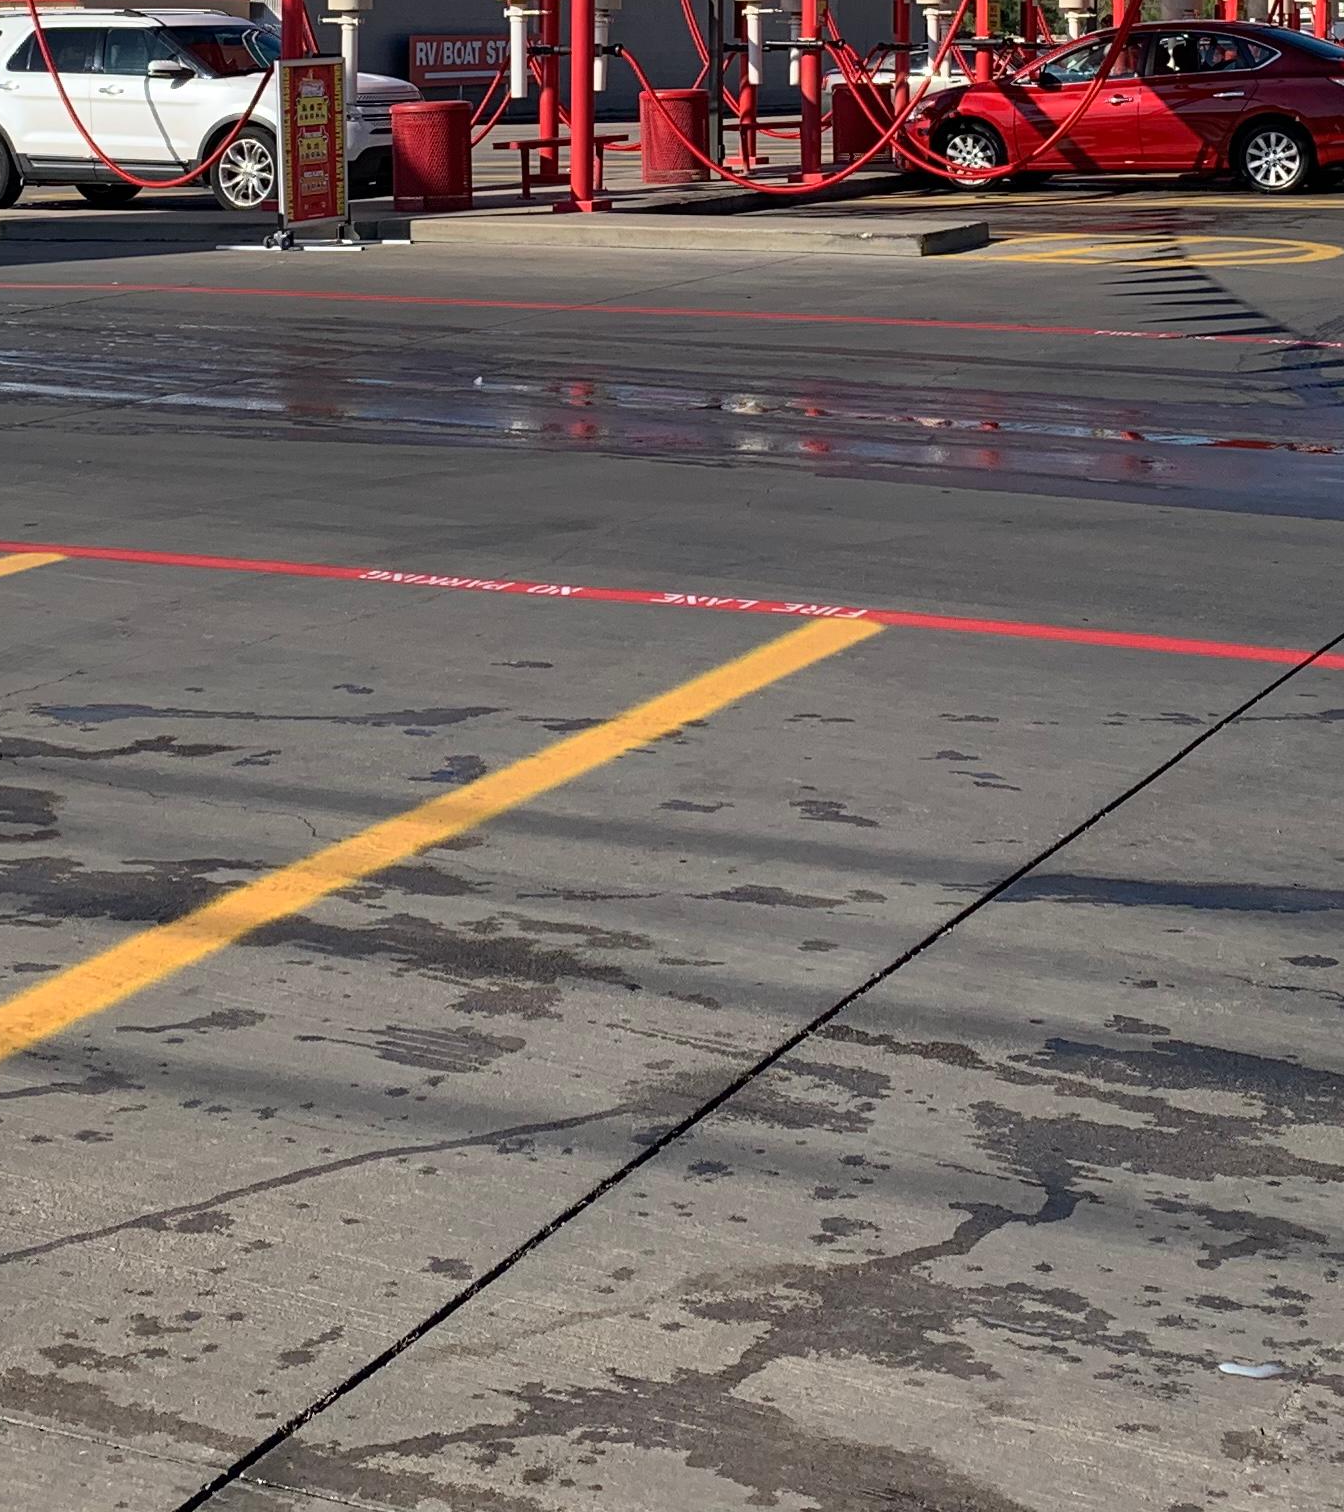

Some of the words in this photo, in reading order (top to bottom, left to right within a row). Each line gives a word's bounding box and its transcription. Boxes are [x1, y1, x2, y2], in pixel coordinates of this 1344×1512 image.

[416, 40, 483, 66] RV/BOAT
[359, 570, 515, 591] PARKING
[527, 584, 583, 596] NO
[650, 592, 759, 610] LANE
[771, 602, 868, 619] FIRE
